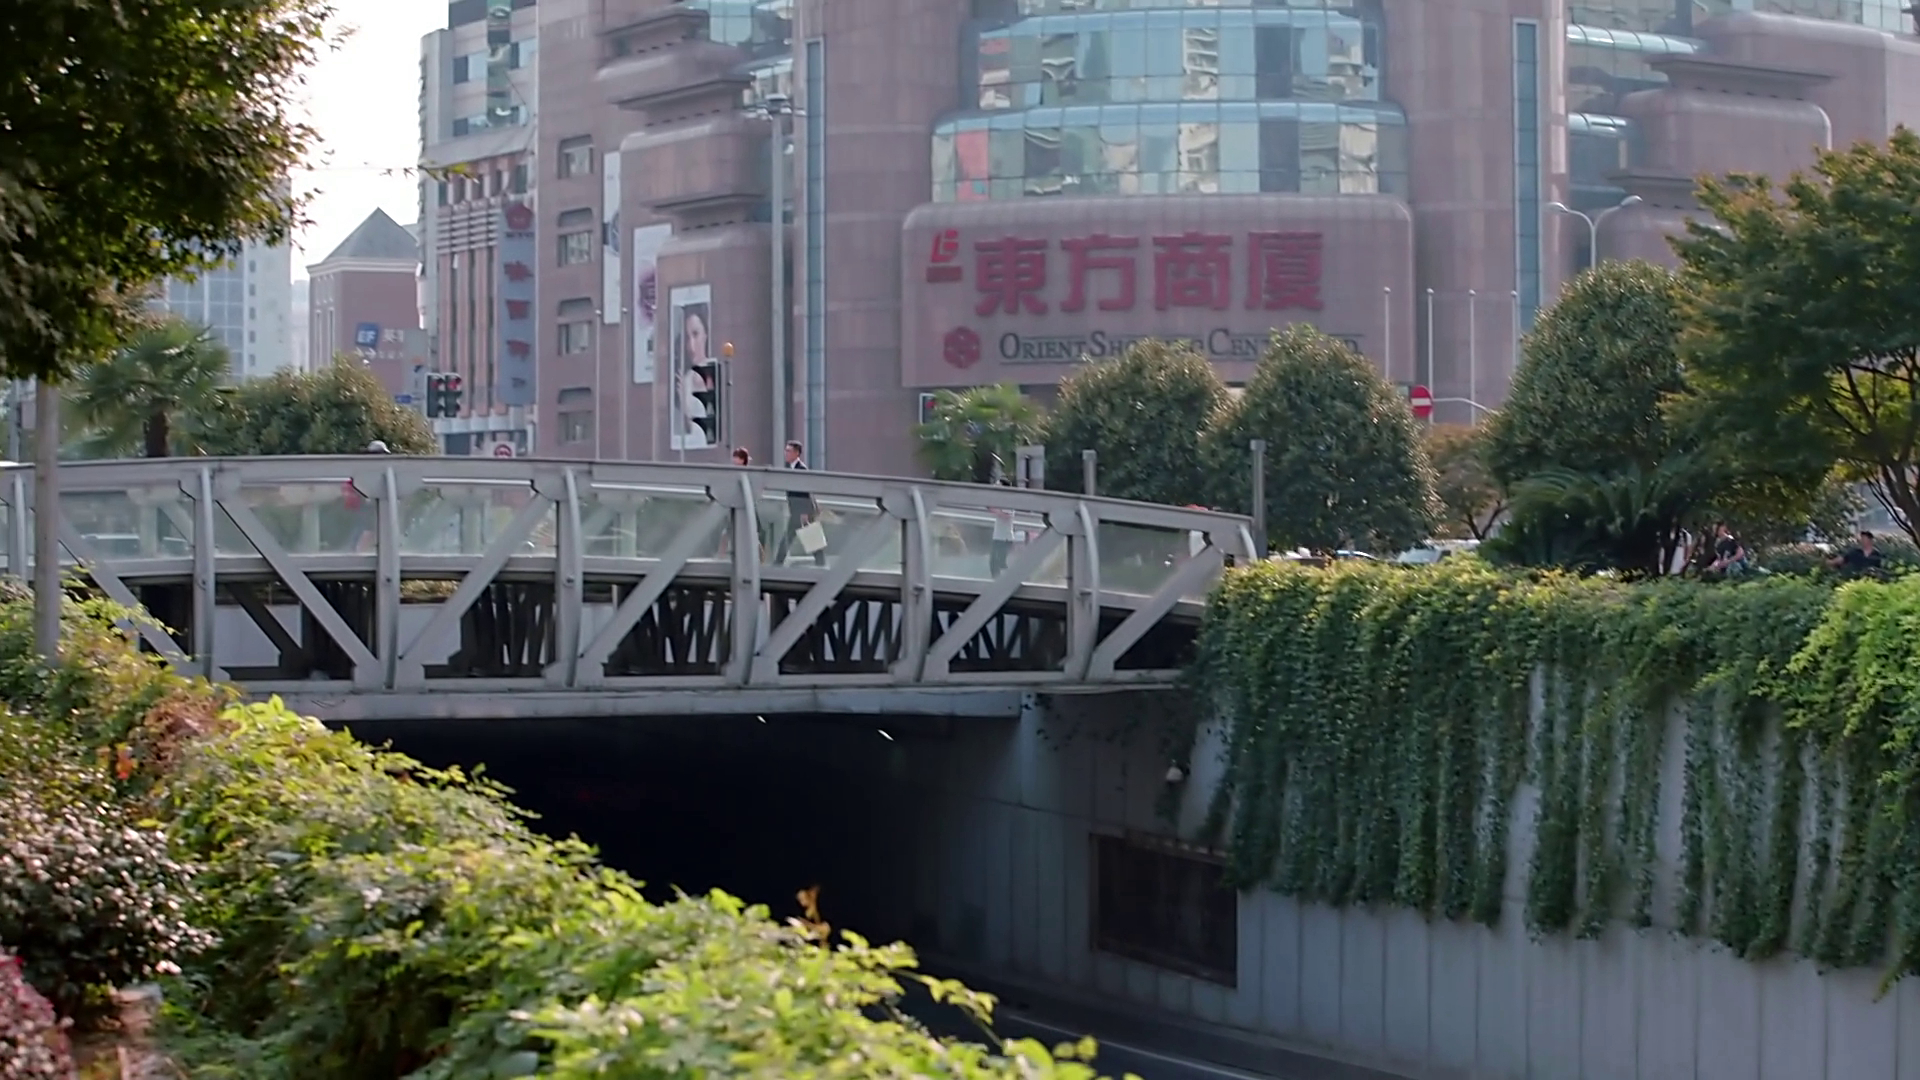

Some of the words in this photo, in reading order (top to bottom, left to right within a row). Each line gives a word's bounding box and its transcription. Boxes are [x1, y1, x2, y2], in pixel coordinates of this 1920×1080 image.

[974, 231, 1325, 316] 東方商厦
[1000, 332, 1086, 359] ORIENT
